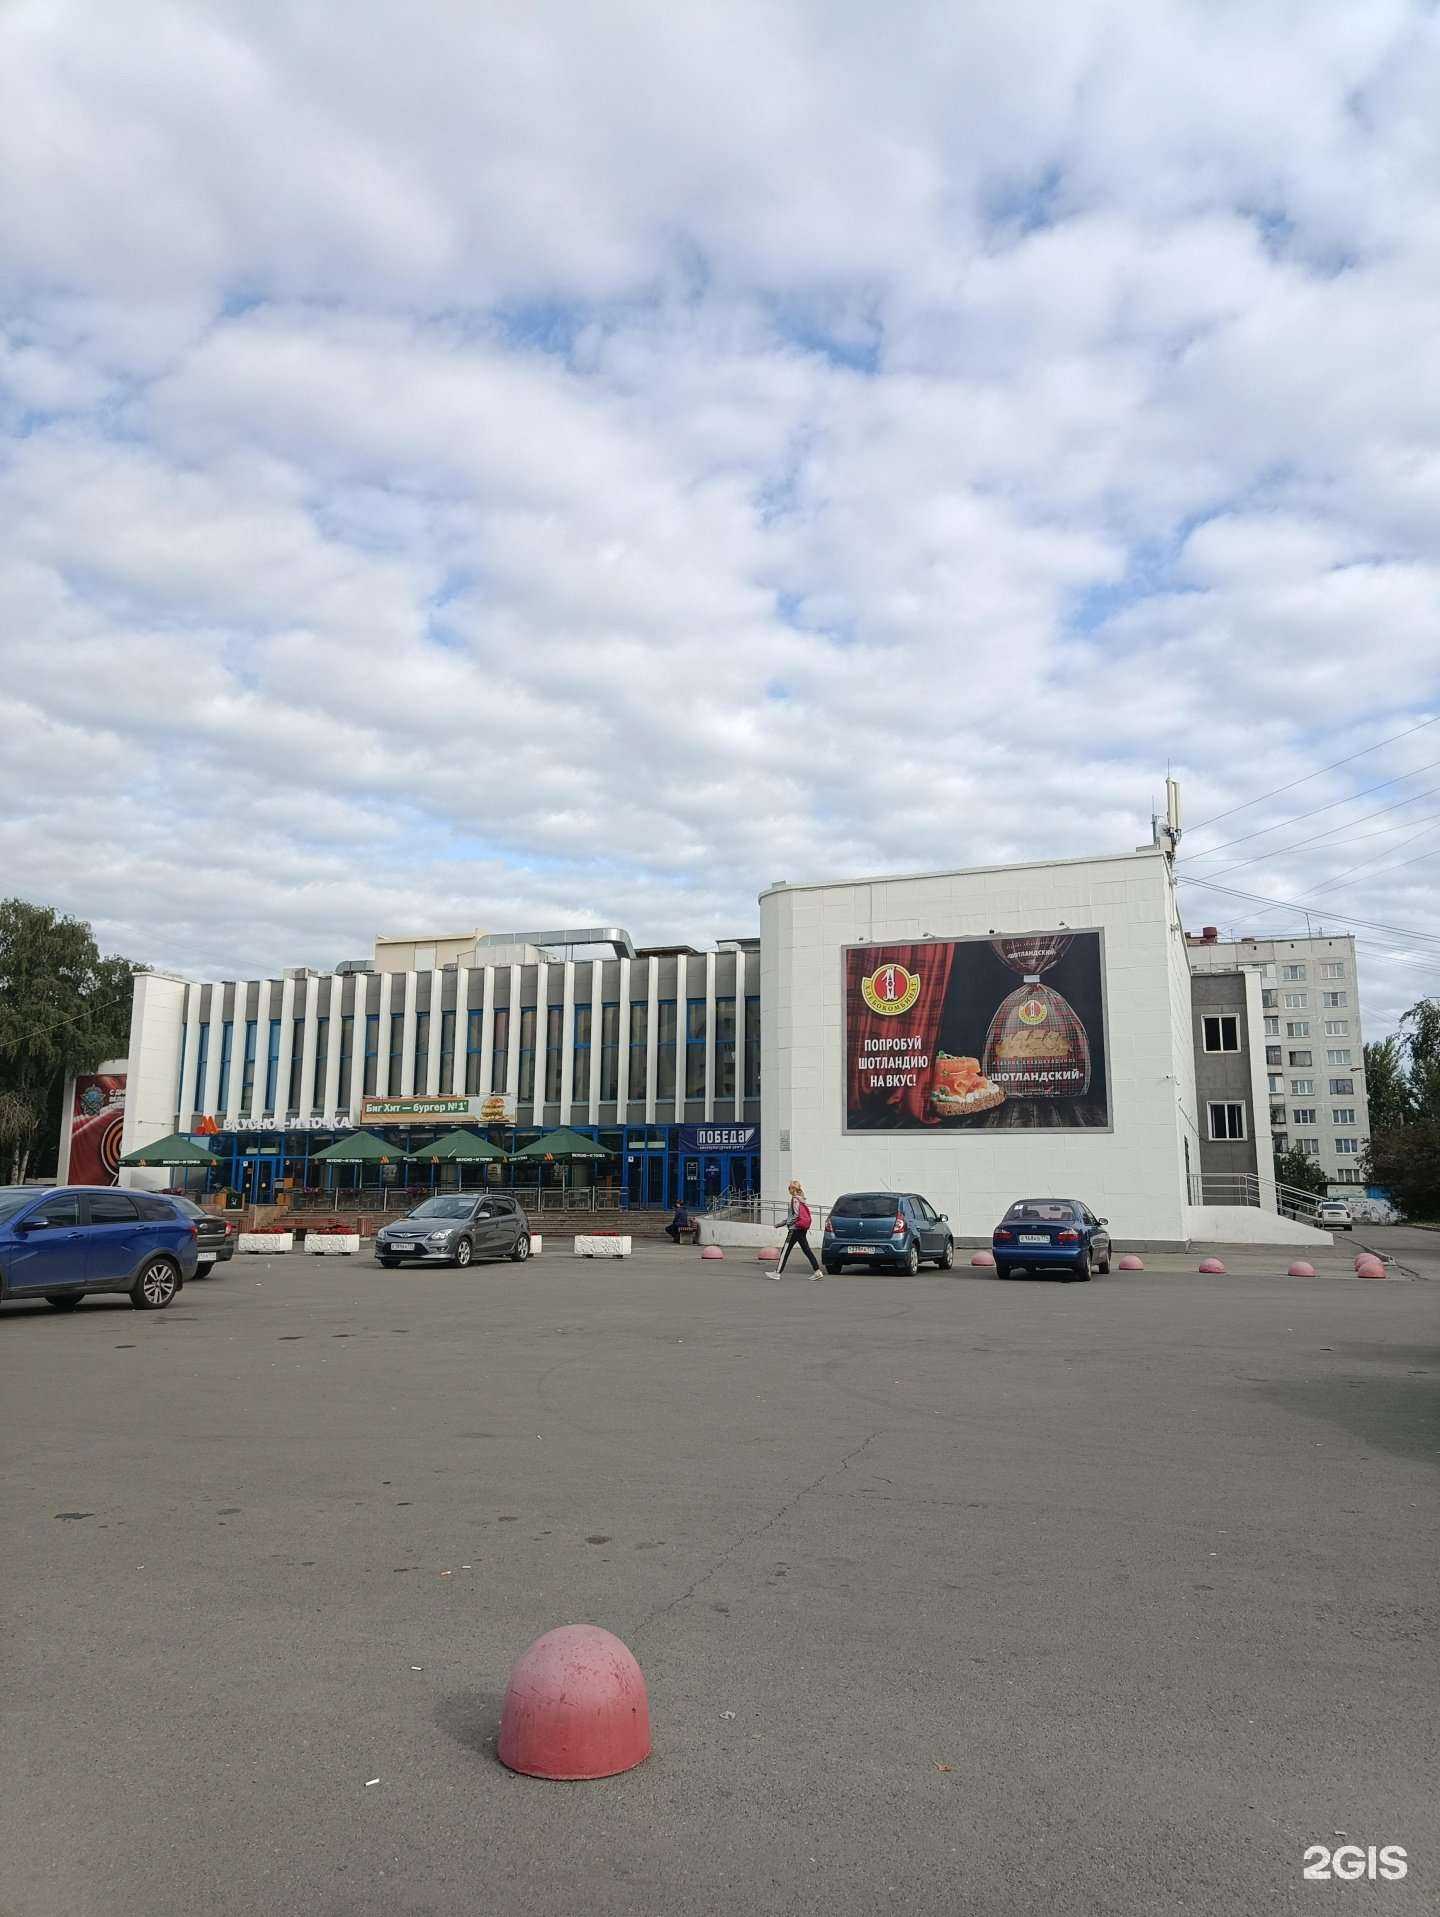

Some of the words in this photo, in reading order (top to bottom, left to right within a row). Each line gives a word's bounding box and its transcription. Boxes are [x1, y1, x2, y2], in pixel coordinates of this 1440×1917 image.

[864, 1035, 922, 1052] ПОПРОБУЙ
[858, 1055, 929, 1070] ШОТЛАНДИЮ
[870, 1075, 885, 1087] НА
[886, 1074, 917, 1087] ВКУС!
[366, 1104, 382, 1113] Биг
[384, 1103, 401, 1112] Хит
[413, 1103, 446, 1113] бургер
